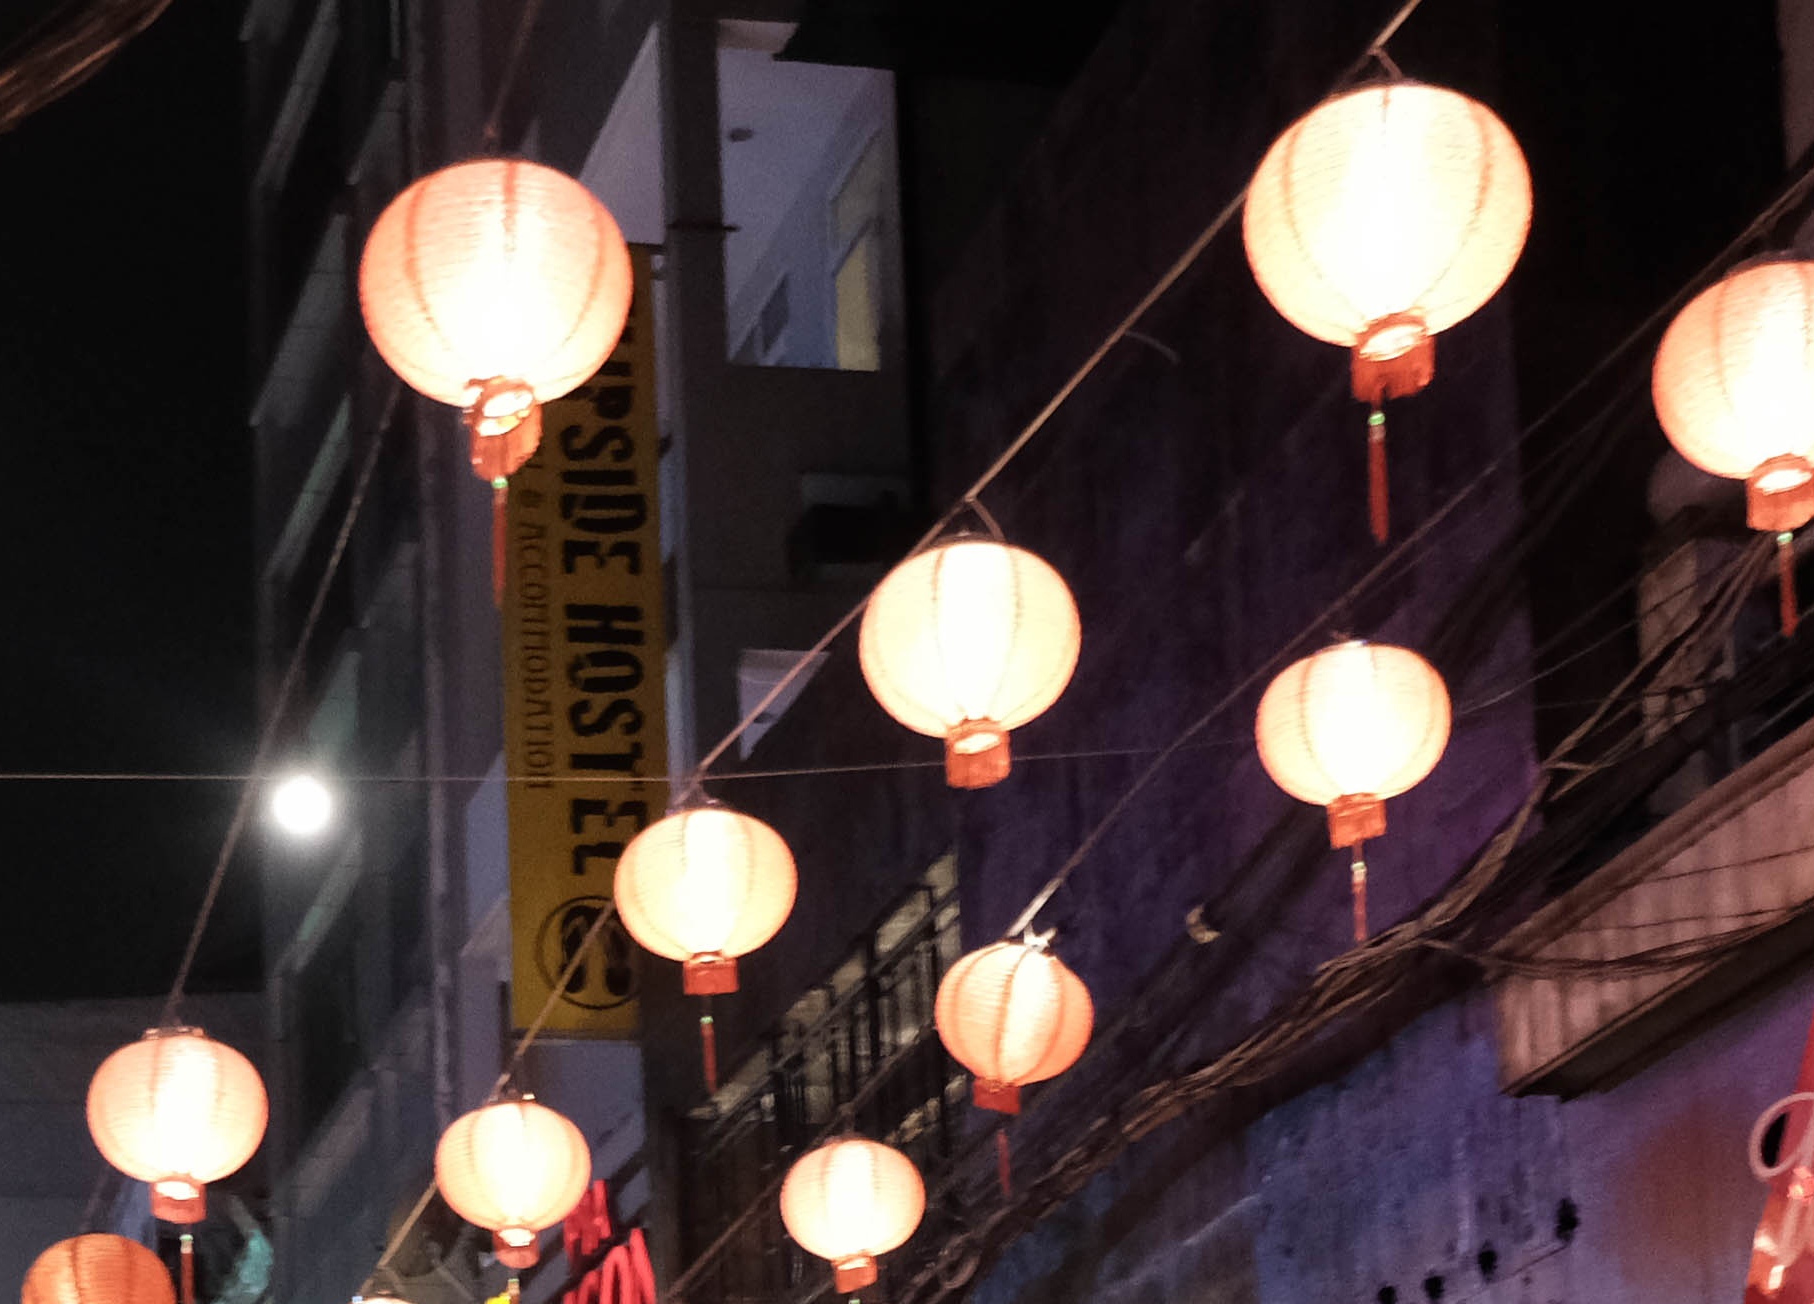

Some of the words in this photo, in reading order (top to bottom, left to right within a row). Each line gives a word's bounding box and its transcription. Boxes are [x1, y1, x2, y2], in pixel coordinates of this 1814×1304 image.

[560, 312, 649, 577] PSIDE
[518, 522, 556, 792] ACCOMMODATION
[565, 602, 649, 878] HOSTEL
